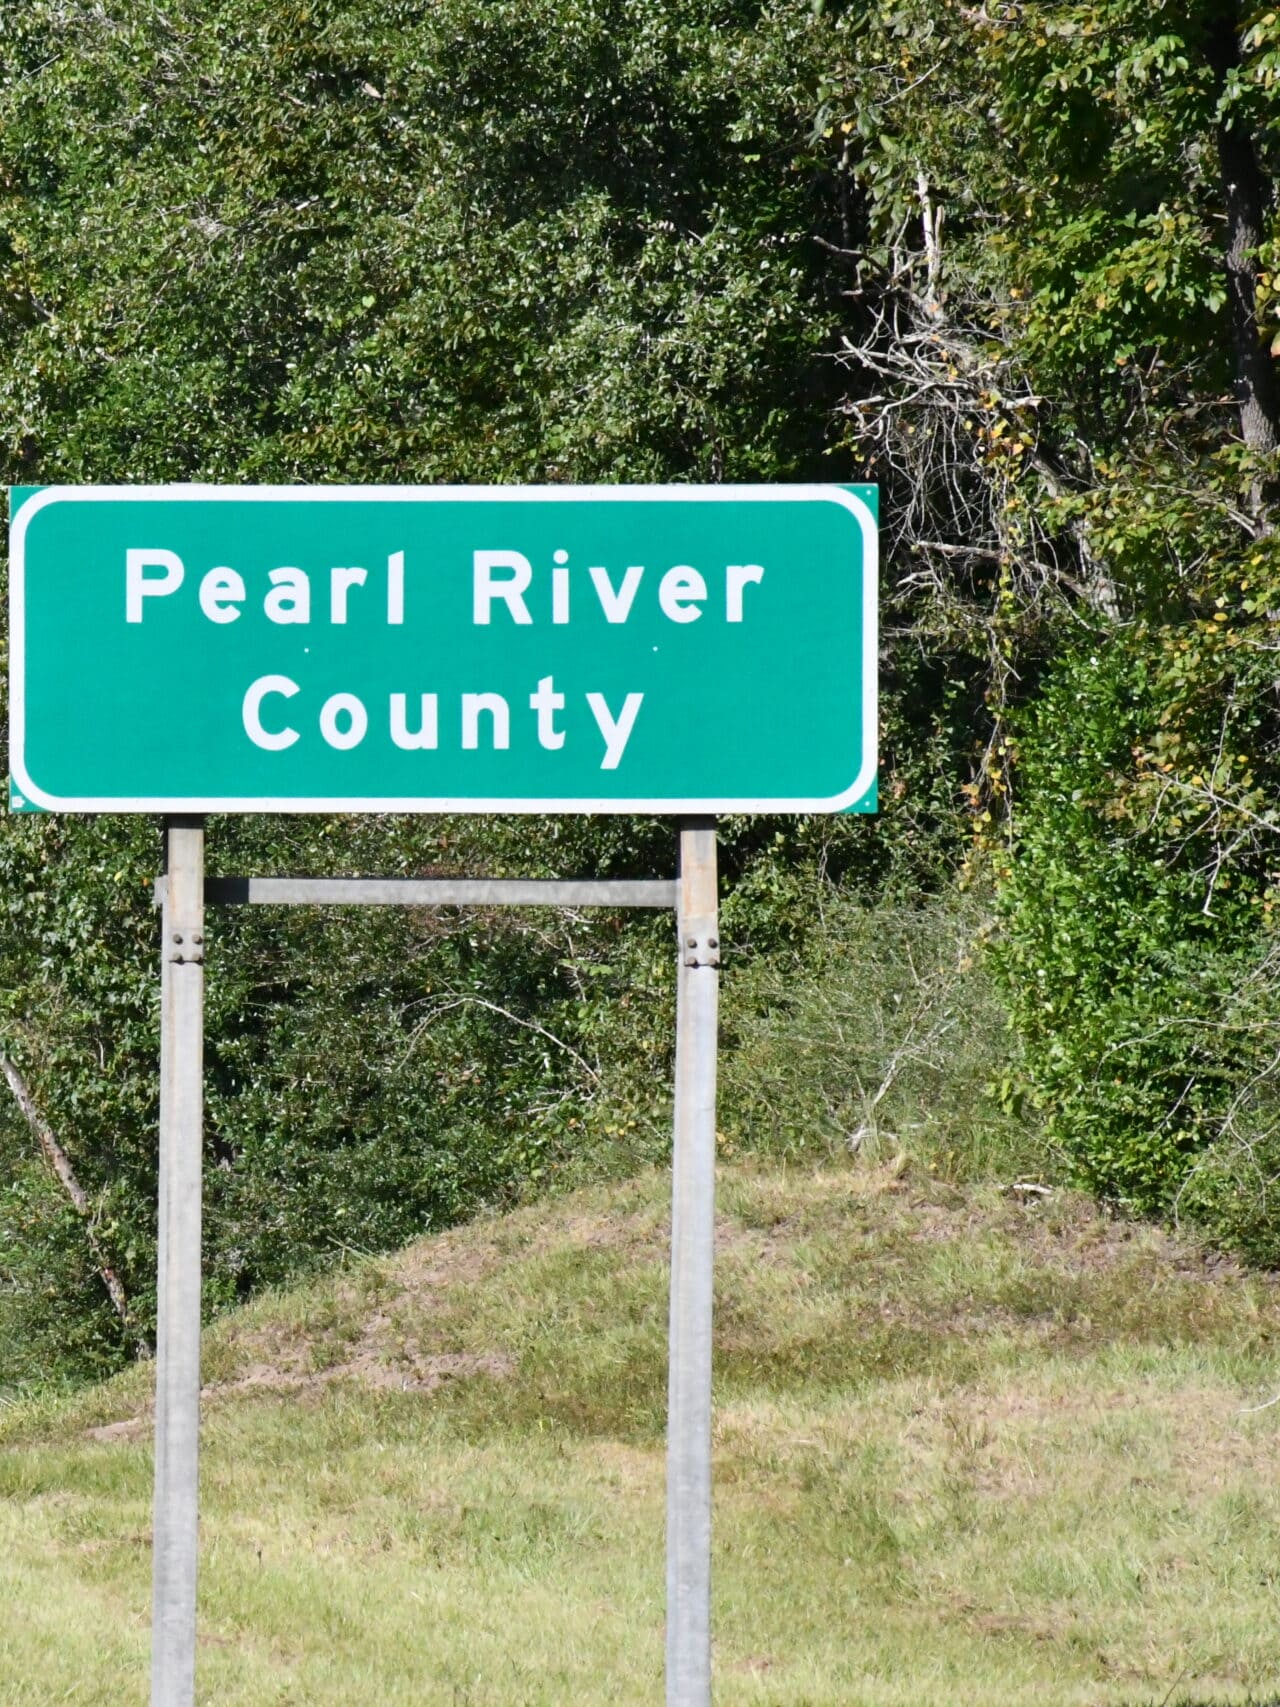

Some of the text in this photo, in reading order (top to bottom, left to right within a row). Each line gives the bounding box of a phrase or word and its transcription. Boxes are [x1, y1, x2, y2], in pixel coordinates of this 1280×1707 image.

[125, 549, 766, 625] Pearl River
[241, 674, 644, 770] County
